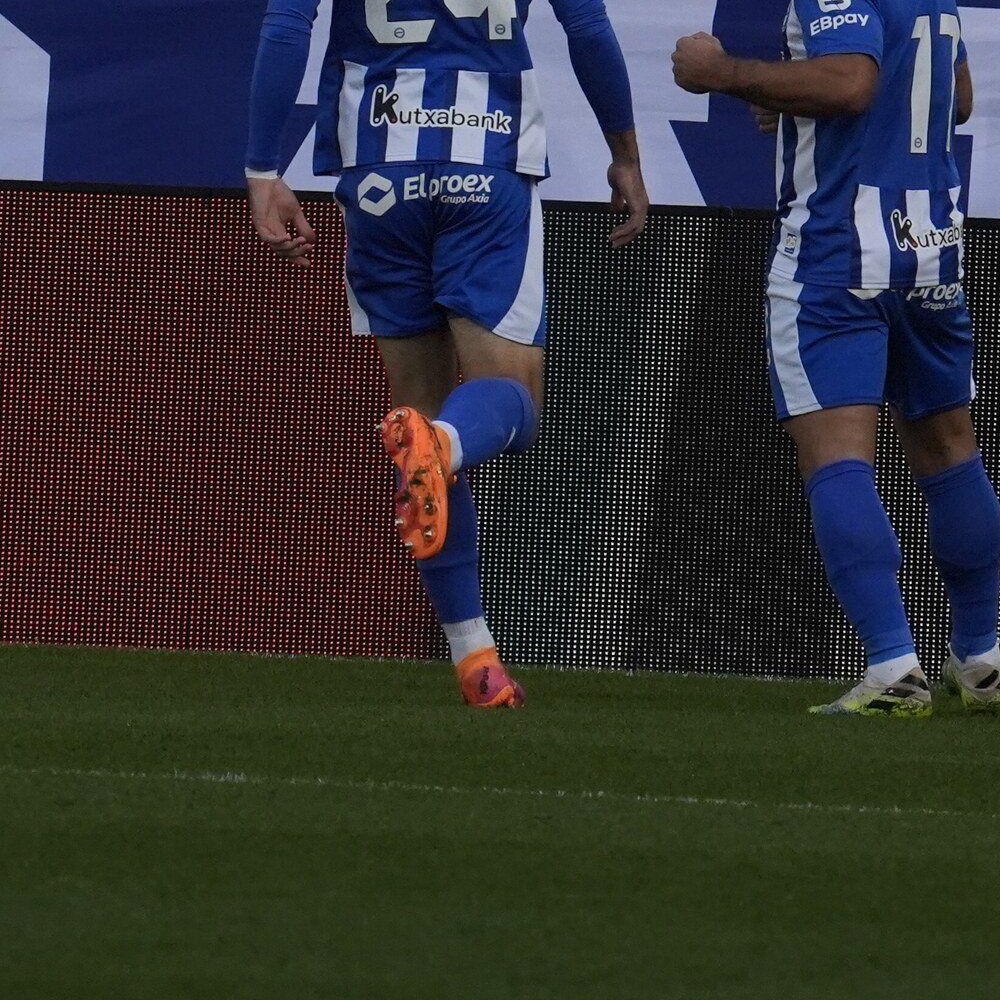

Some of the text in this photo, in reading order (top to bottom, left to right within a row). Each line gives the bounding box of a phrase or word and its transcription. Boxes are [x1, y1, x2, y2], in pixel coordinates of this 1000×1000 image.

[810, 14, 869, 36] EBpay
[910, 13, 961, 154] 17
[371, 85, 512, 134] Kutxabank
